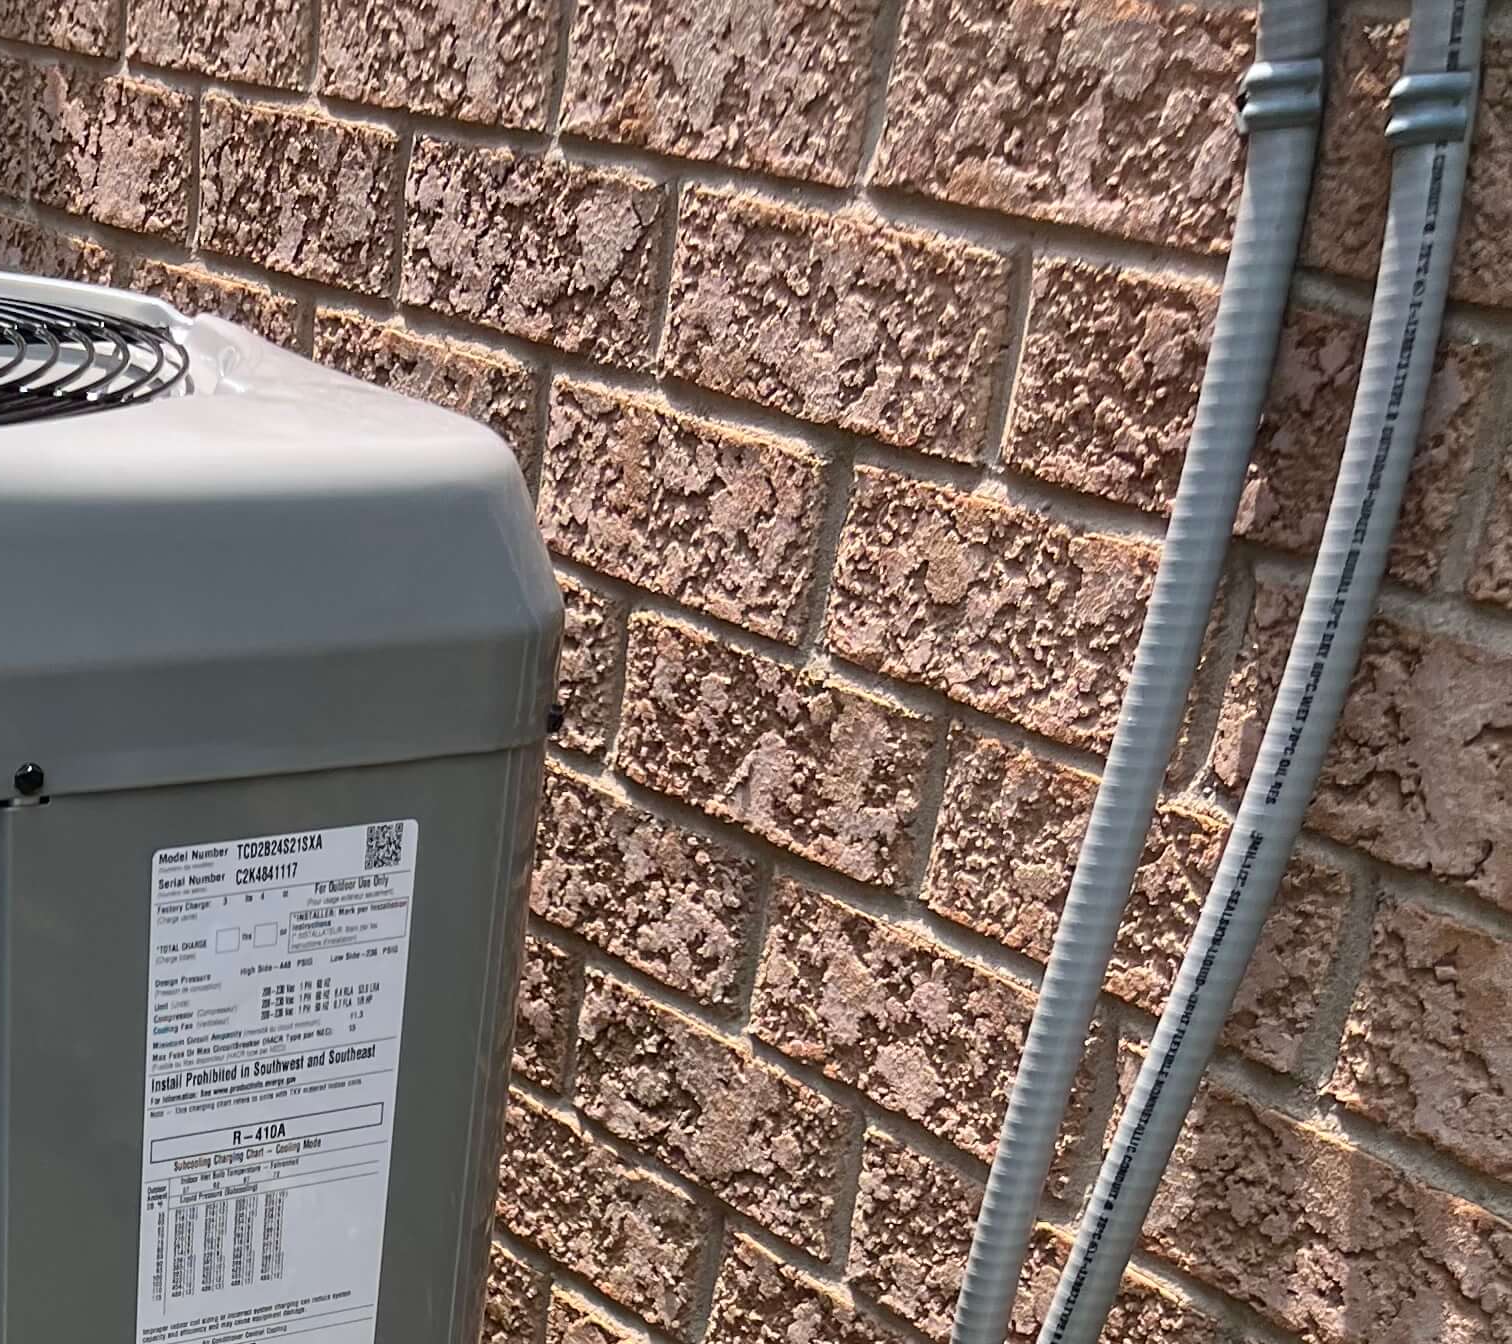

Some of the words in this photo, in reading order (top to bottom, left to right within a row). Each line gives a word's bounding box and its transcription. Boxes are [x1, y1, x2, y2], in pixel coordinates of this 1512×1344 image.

[1295, 695, 1314, 722] WET
[1274, 758, 1291, 777] OIL
[159, 852, 188, 865] Model
[192, 847, 229, 861] Number
[237, 834, 322, 860] TCD2B24S21SXA
[158, 877, 186, 890] Serial
[189, 873, 226, 886] Number
[236, 862, 299, 885] C2K4841117
[315, 882, 327, 894] For
[329, 879, 356, 893] Outdoor
[358, 878, 371, 889] Use
[374, 874, 389, 889] Only
[151, 1073, 183, 1093] Install
[186, 1064, 237, 1088] Prohibited
[240, 1064, 250, 1079] in
[254, 1055, 304, 1077] Southwest
[307, 1051, 325, 1068] and
[328, 1043, 376, 1065] Southeast
[173, 1157, 212, 1172] Subcooling
[213, 1150, 244, 1166] Charging
[246, 1147, 264, 1160] Chart
[275, 1141, 301, 1155] Cooling
[302, 1137, 322, 1150] Mode
[1107, 1152, 1133, 1200] CONDUIT
